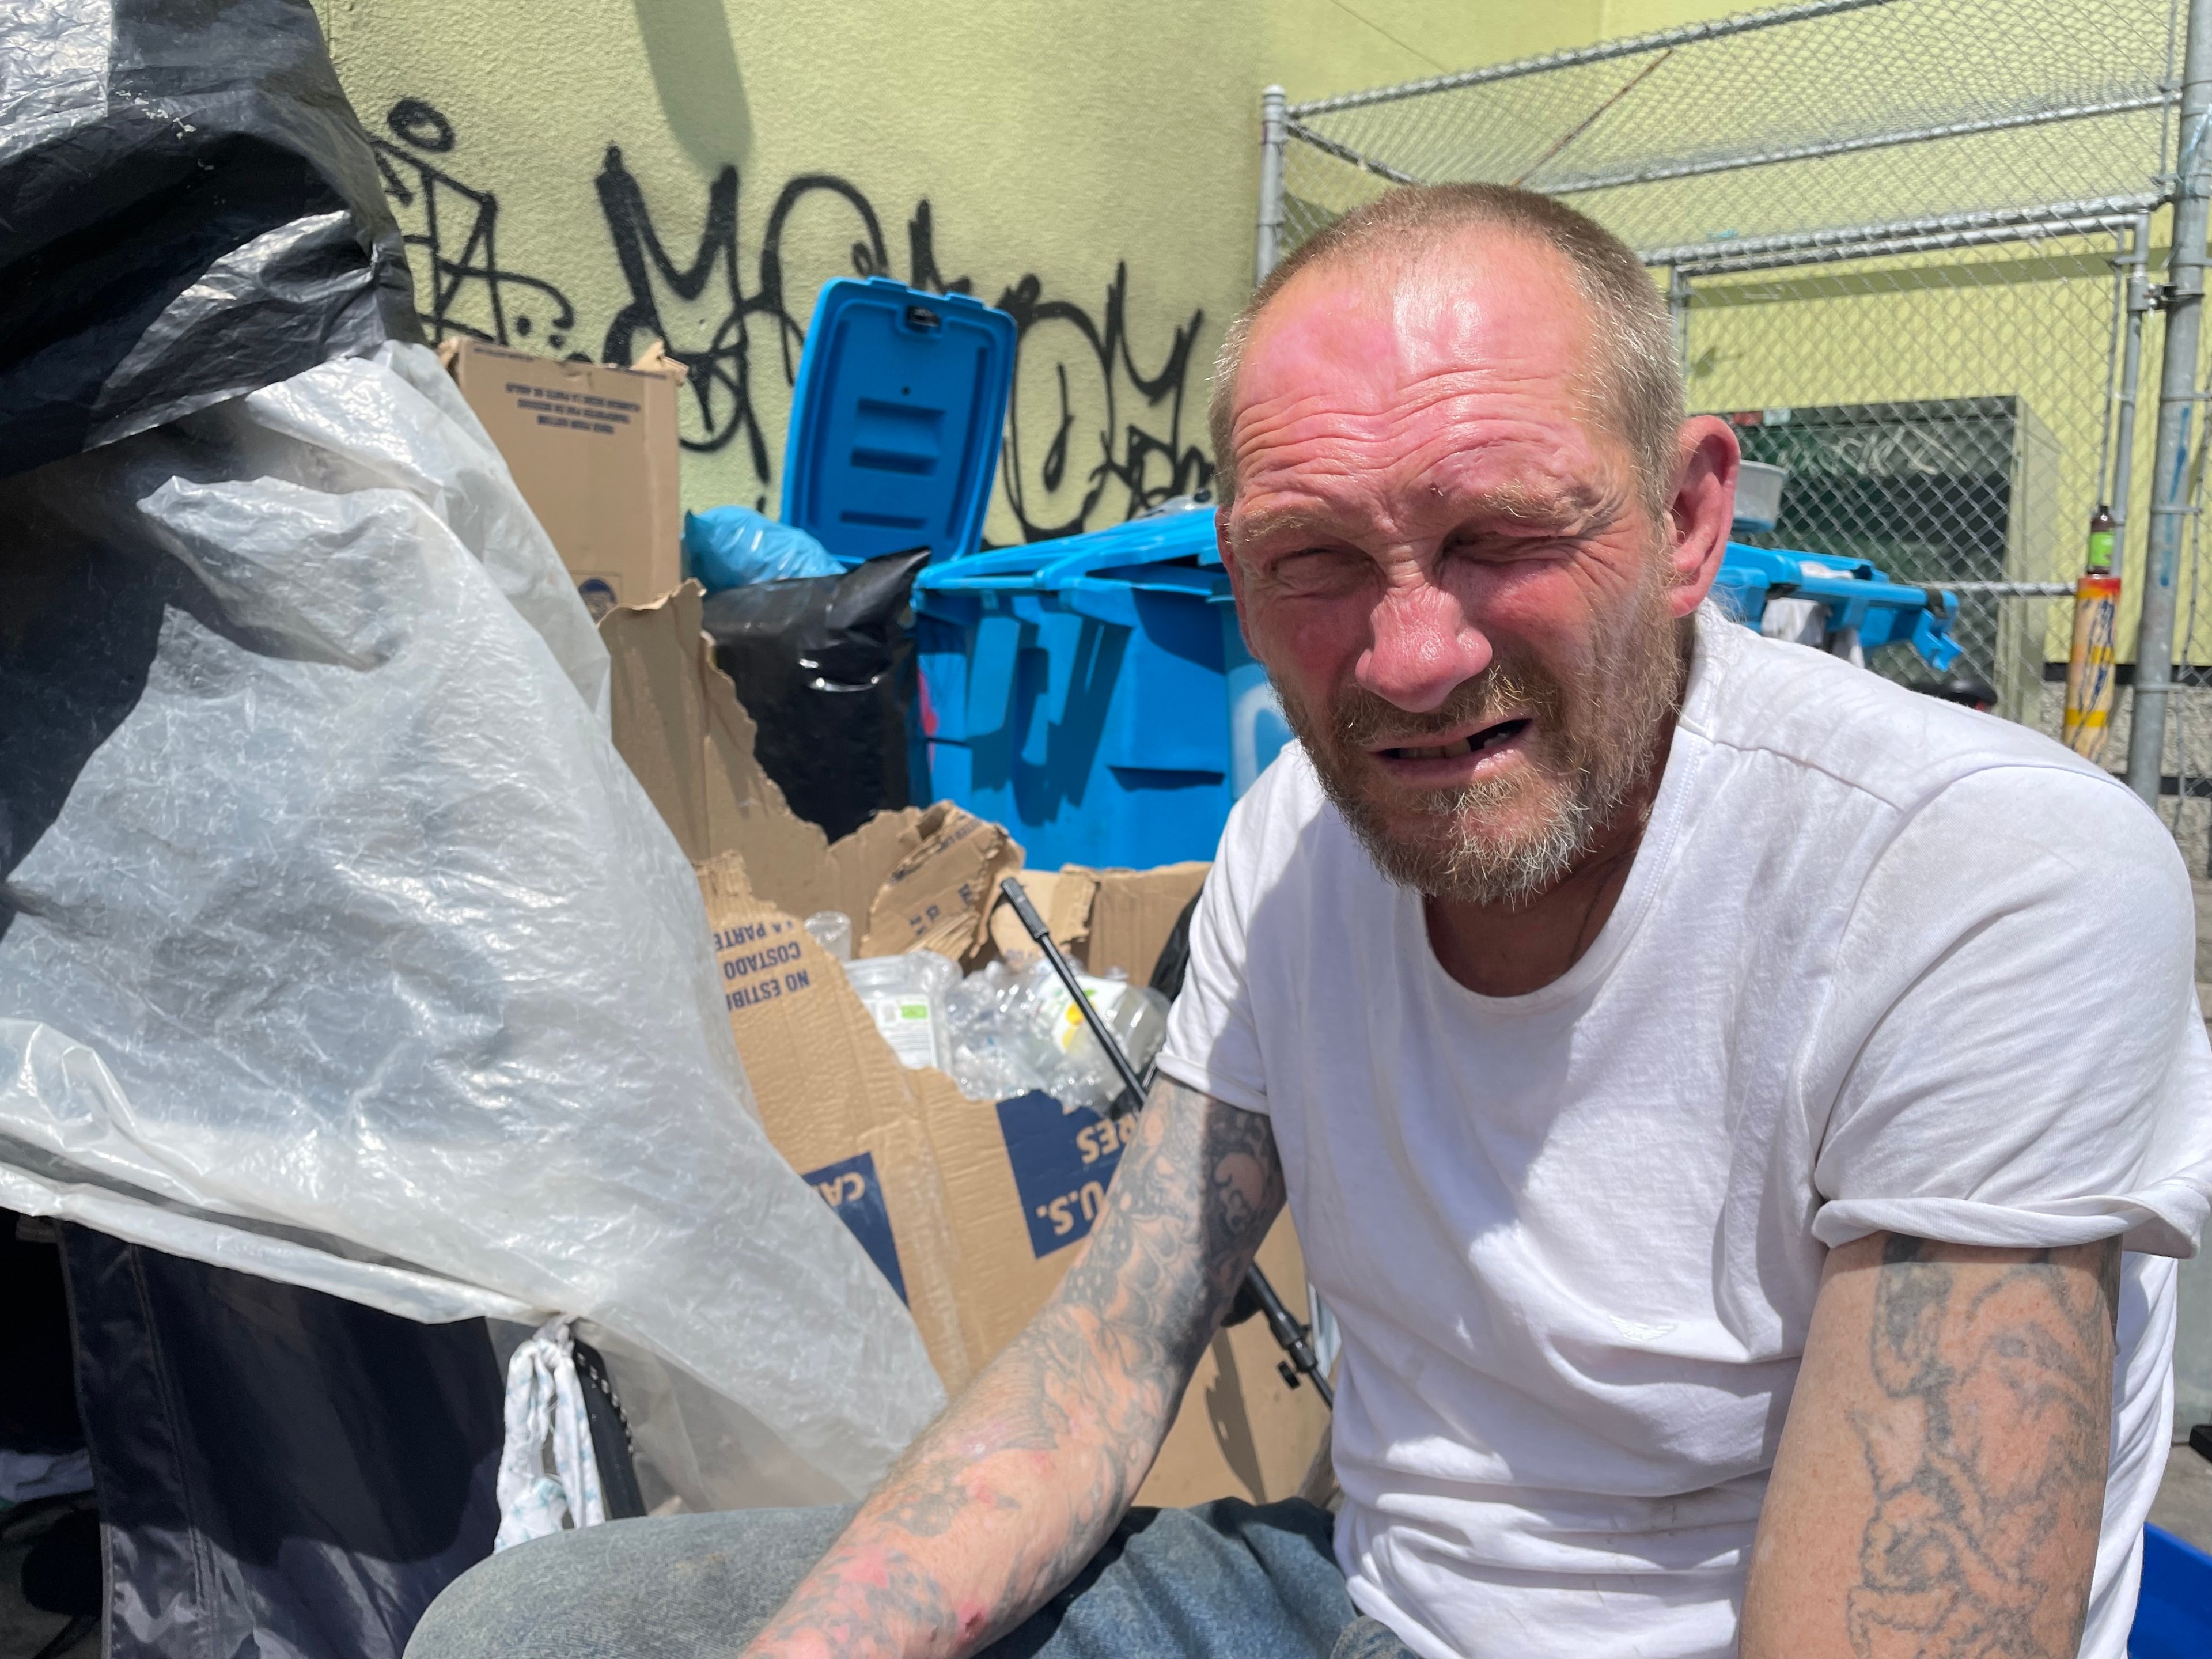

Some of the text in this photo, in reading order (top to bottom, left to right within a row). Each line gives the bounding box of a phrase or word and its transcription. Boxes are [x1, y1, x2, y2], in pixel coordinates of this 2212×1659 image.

[713, 923, 767, 950] PARTE
[724, 941, 801, 980] COSTADO
[785, 969, 810, 993] NO
[812, 1172, 865, 1206] CA
[1036, 1181, 1105, 1236] U.S.
